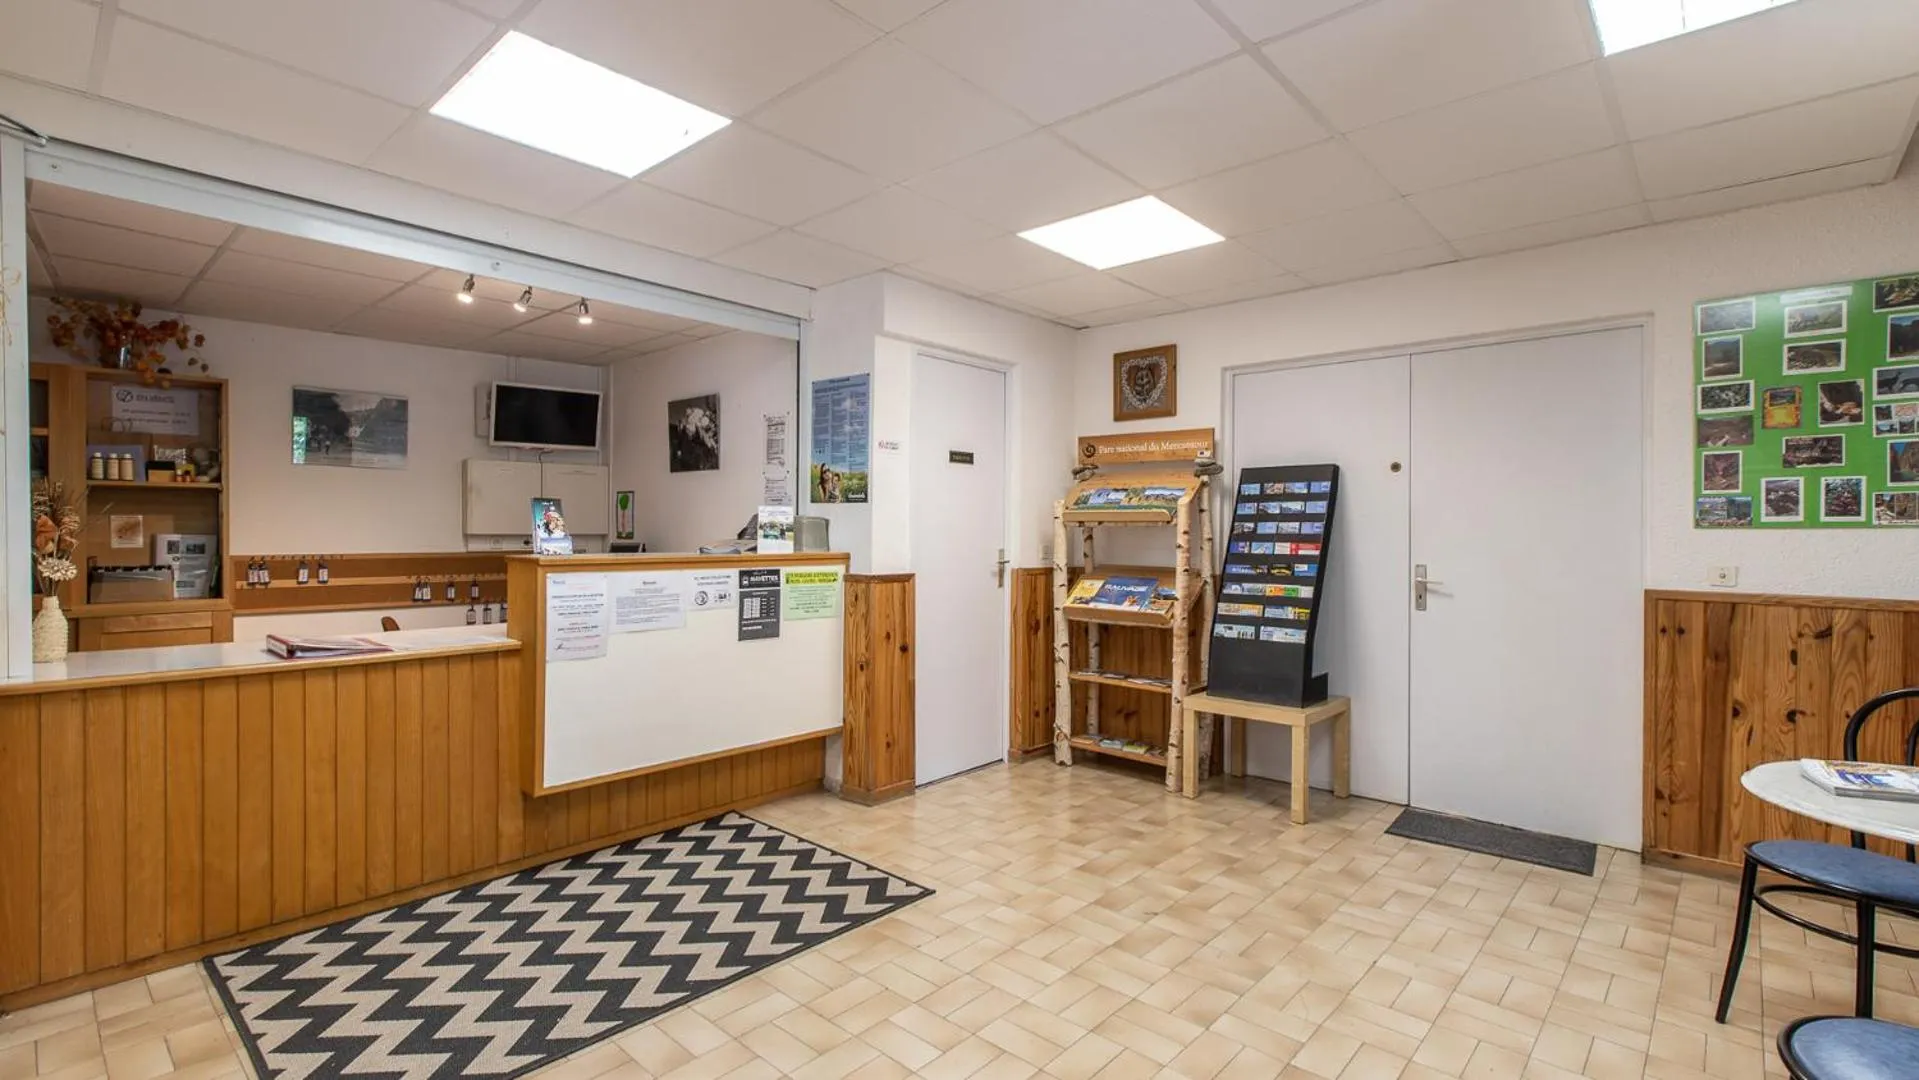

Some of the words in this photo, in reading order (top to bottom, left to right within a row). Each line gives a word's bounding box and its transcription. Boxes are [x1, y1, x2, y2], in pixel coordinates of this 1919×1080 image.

[1099, 446, 1114, 454] Parc
[1116, 442, 1147, 453] national
[1149, 442, 1159, 451] du
